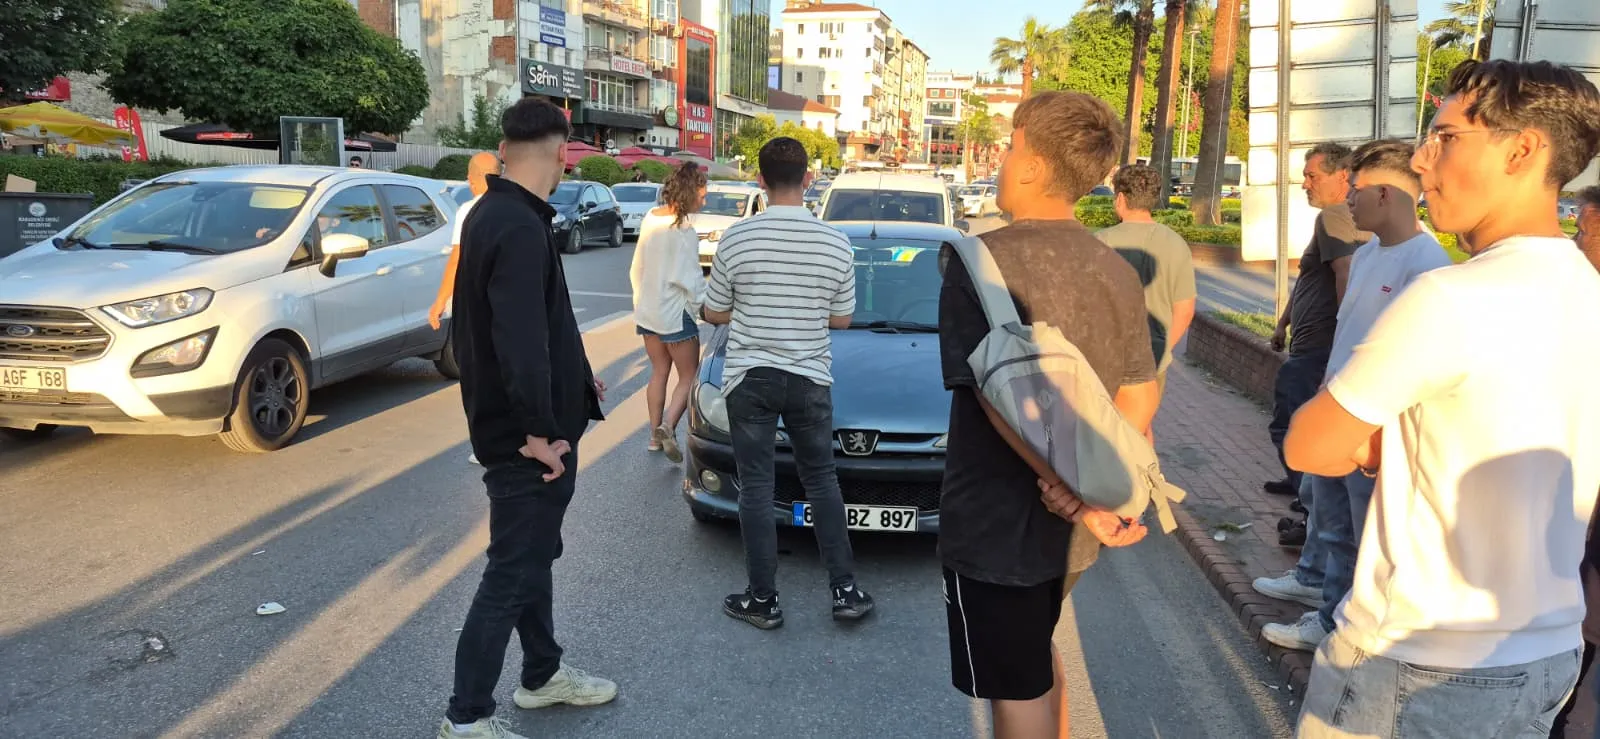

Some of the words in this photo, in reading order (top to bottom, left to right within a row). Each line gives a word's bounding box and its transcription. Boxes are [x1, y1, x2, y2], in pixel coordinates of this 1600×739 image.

[613, 59, 631, 73] HOTEL
[692, 106, 706, 118] HAS
[3, 369, 27, 386] AGF
[37, 371, 62, 387] 168
[804, 506, 813, 523] 6
[847, 508, 870, 527] BZ
[880, 510, 914, 529] 897
